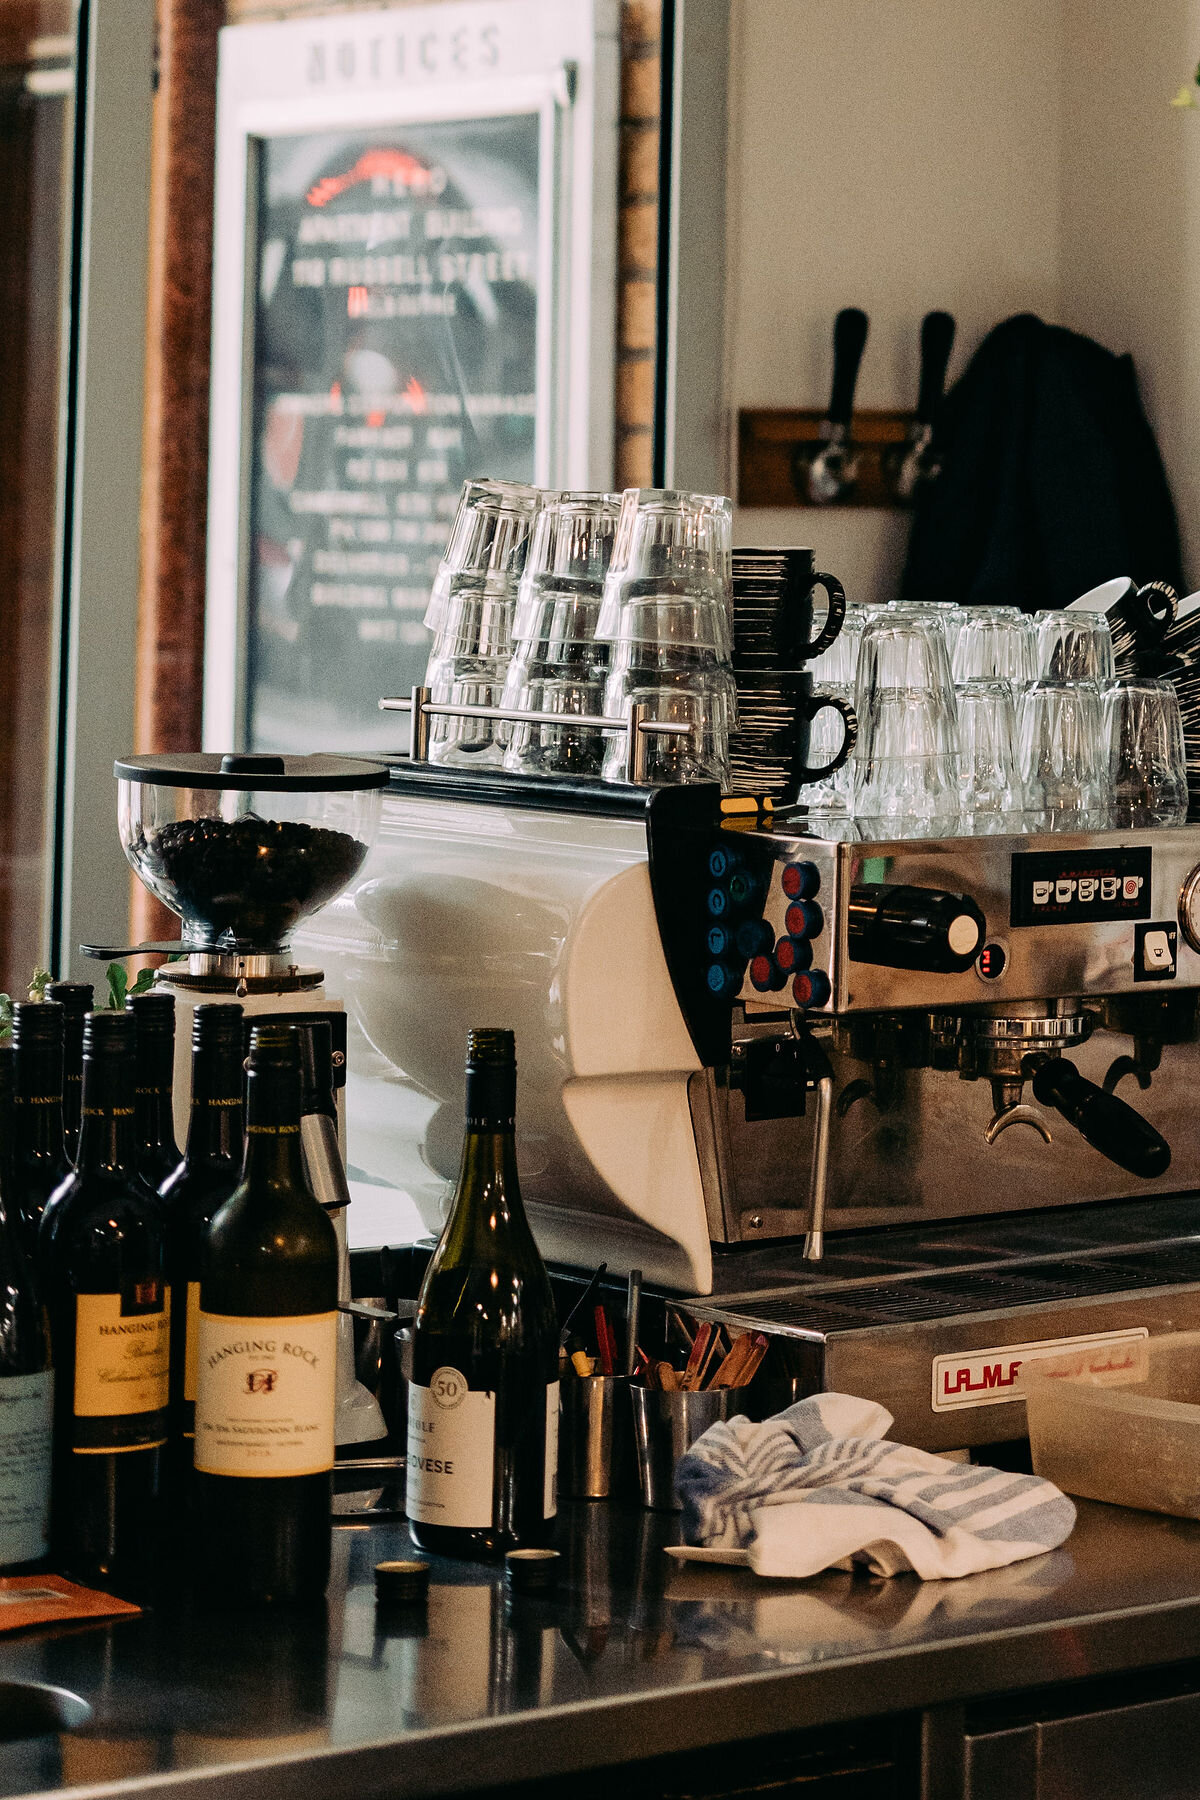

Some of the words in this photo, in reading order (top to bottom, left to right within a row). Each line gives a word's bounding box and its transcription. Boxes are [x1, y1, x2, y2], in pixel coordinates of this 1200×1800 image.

[305, 23, 500, 85] NOTICES
[100, 1320, 154, 1336] HANGING
[207, 1340, 276, 1369] HANGING
[282, 1342, 320, 1368] ROCK
[437, 1380, 458, 1397] 50
